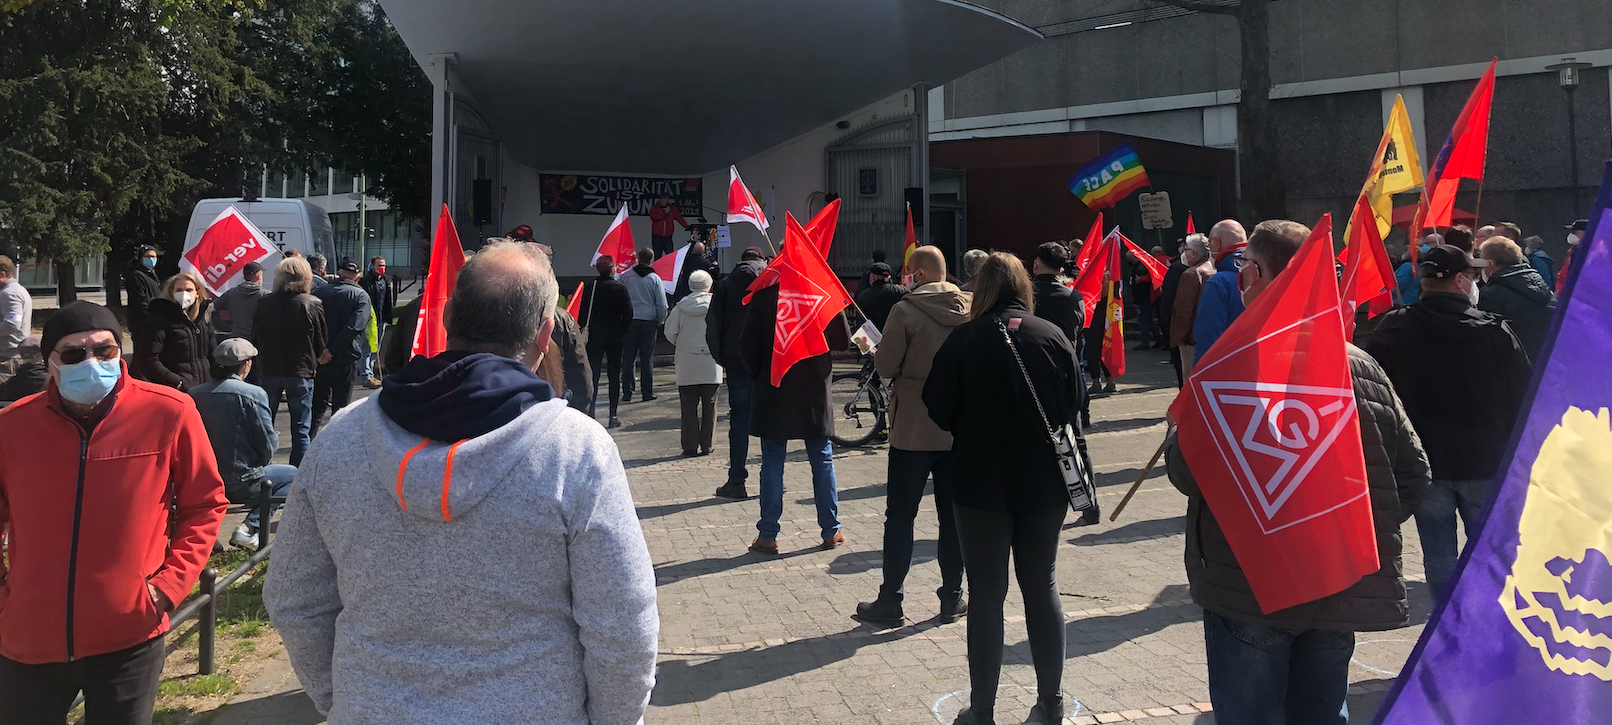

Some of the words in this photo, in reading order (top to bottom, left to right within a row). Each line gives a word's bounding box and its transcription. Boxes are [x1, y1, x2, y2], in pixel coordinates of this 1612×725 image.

[579, 176, 683, 196] SOLIDARITÄT
[617, 190, 645, 200] IST
[680, 207, 700, 215] 2021
[262, 231, 287, 242] RT
